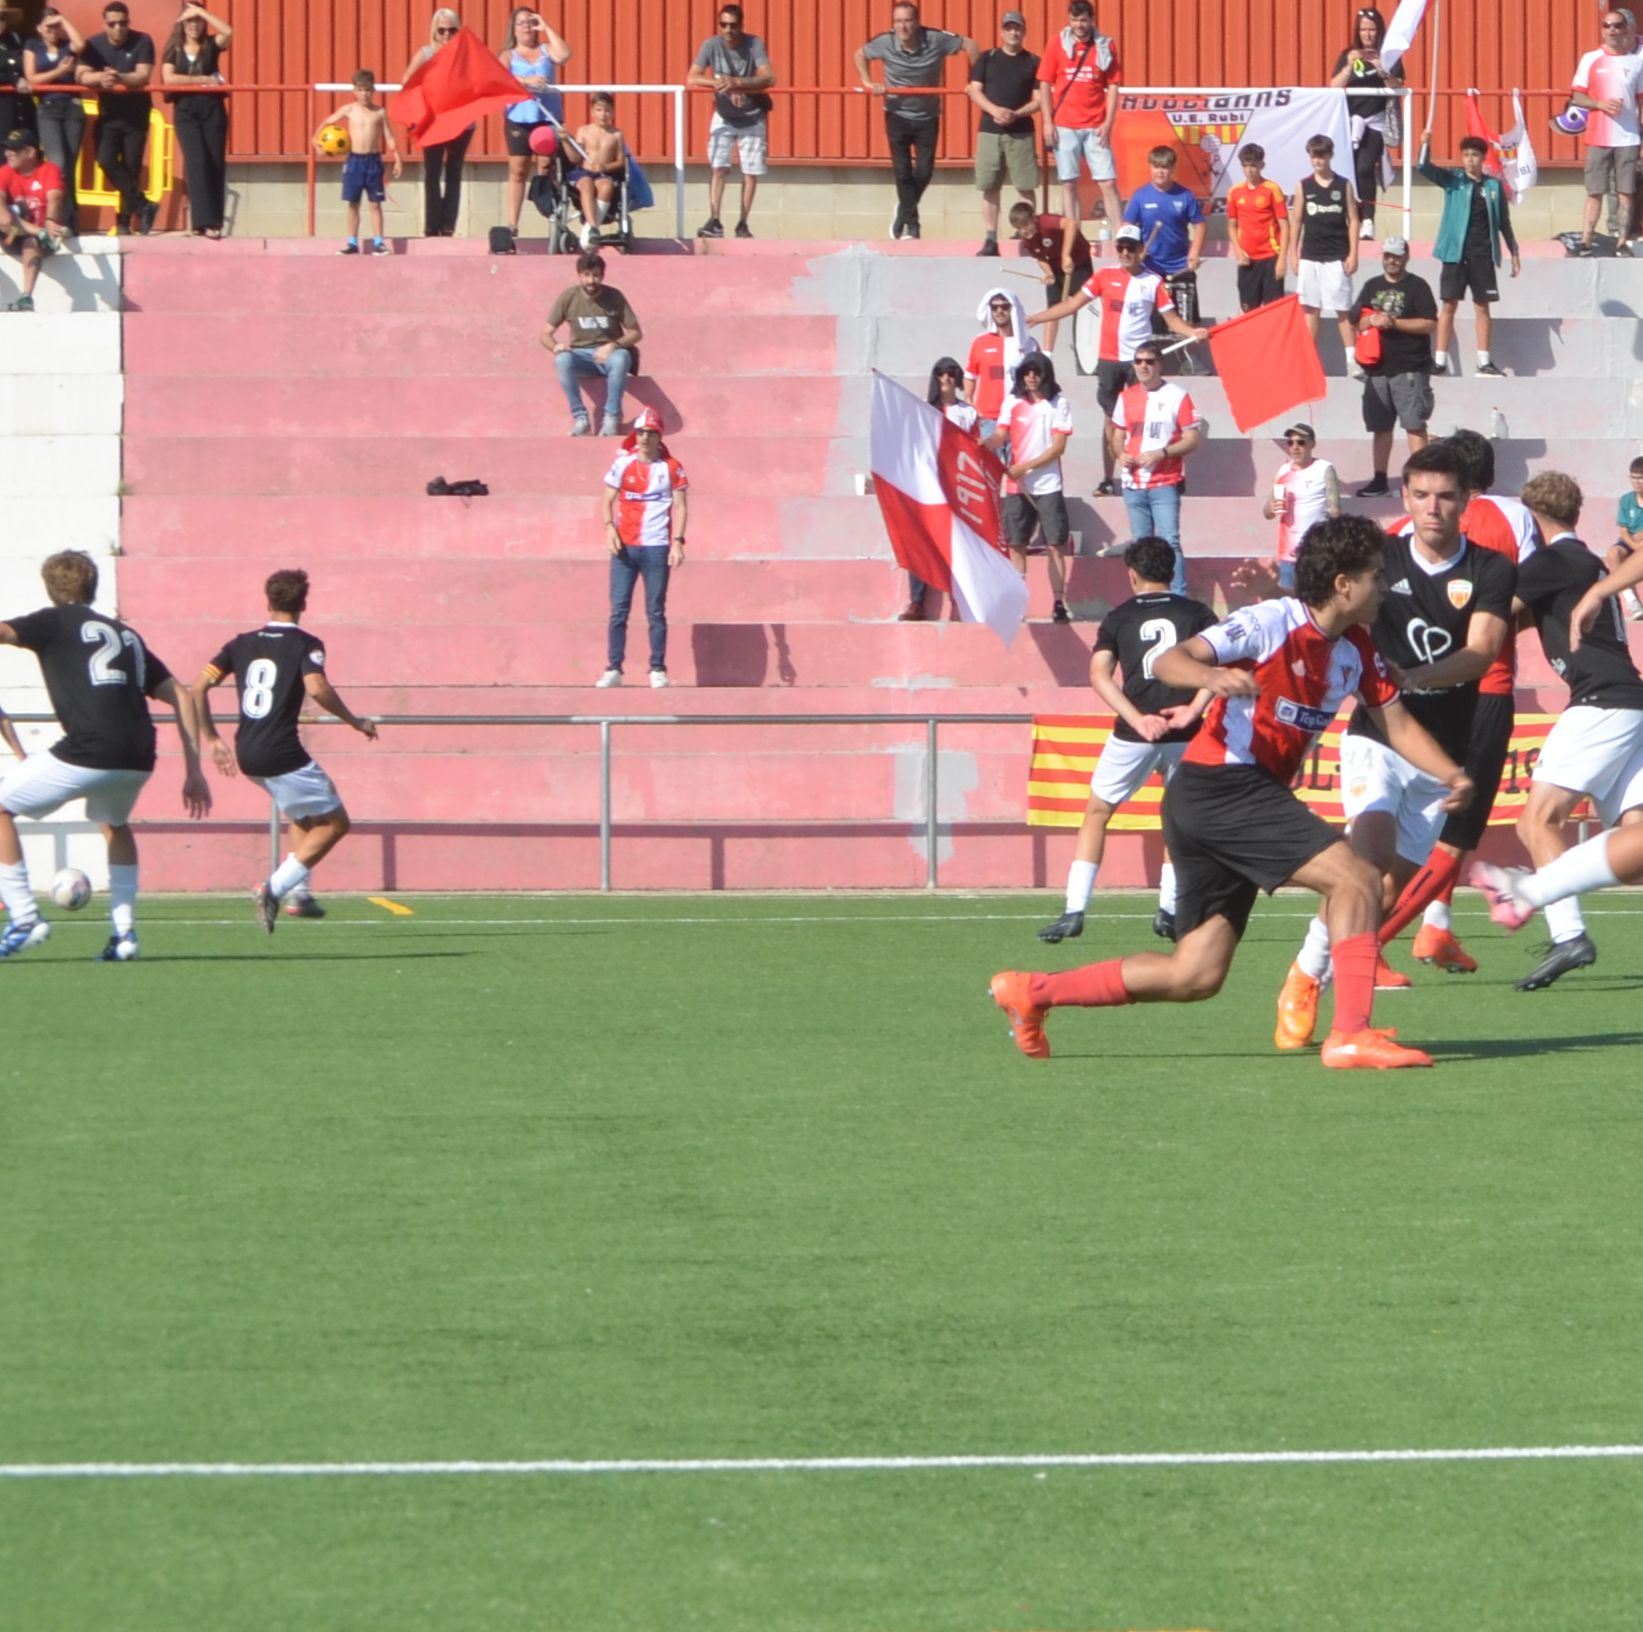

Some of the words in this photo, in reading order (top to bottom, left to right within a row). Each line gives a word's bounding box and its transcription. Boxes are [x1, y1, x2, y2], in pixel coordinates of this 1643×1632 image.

[80, 620, 147, 694] 21
[1139, 618, 1177, 680] 2
[242, 658, 278, 719] 8
